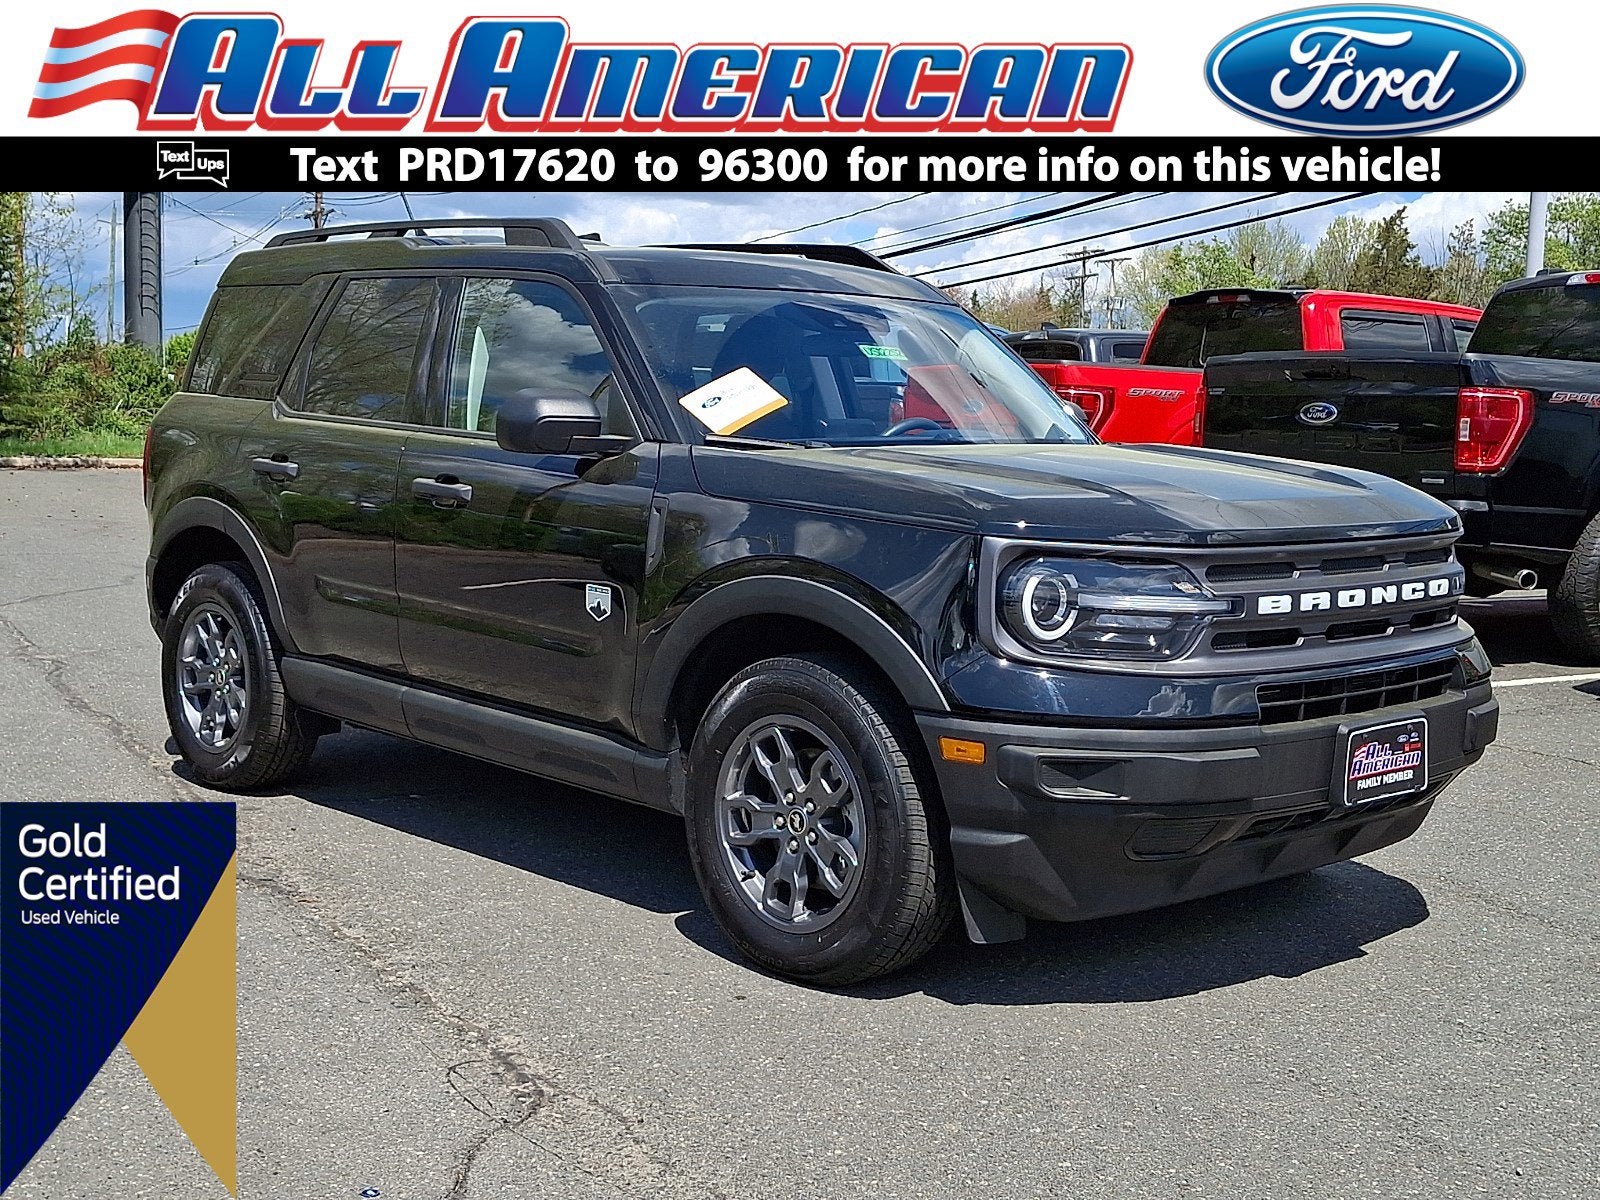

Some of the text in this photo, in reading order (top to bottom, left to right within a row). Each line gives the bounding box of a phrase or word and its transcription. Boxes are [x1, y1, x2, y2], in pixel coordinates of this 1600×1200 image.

[1127, 387, 1185, 398] SPORT
[1257, 578, 1450, 615] BRONCO
[1357, 770, 1414, 790] FAMILY MEMBER
